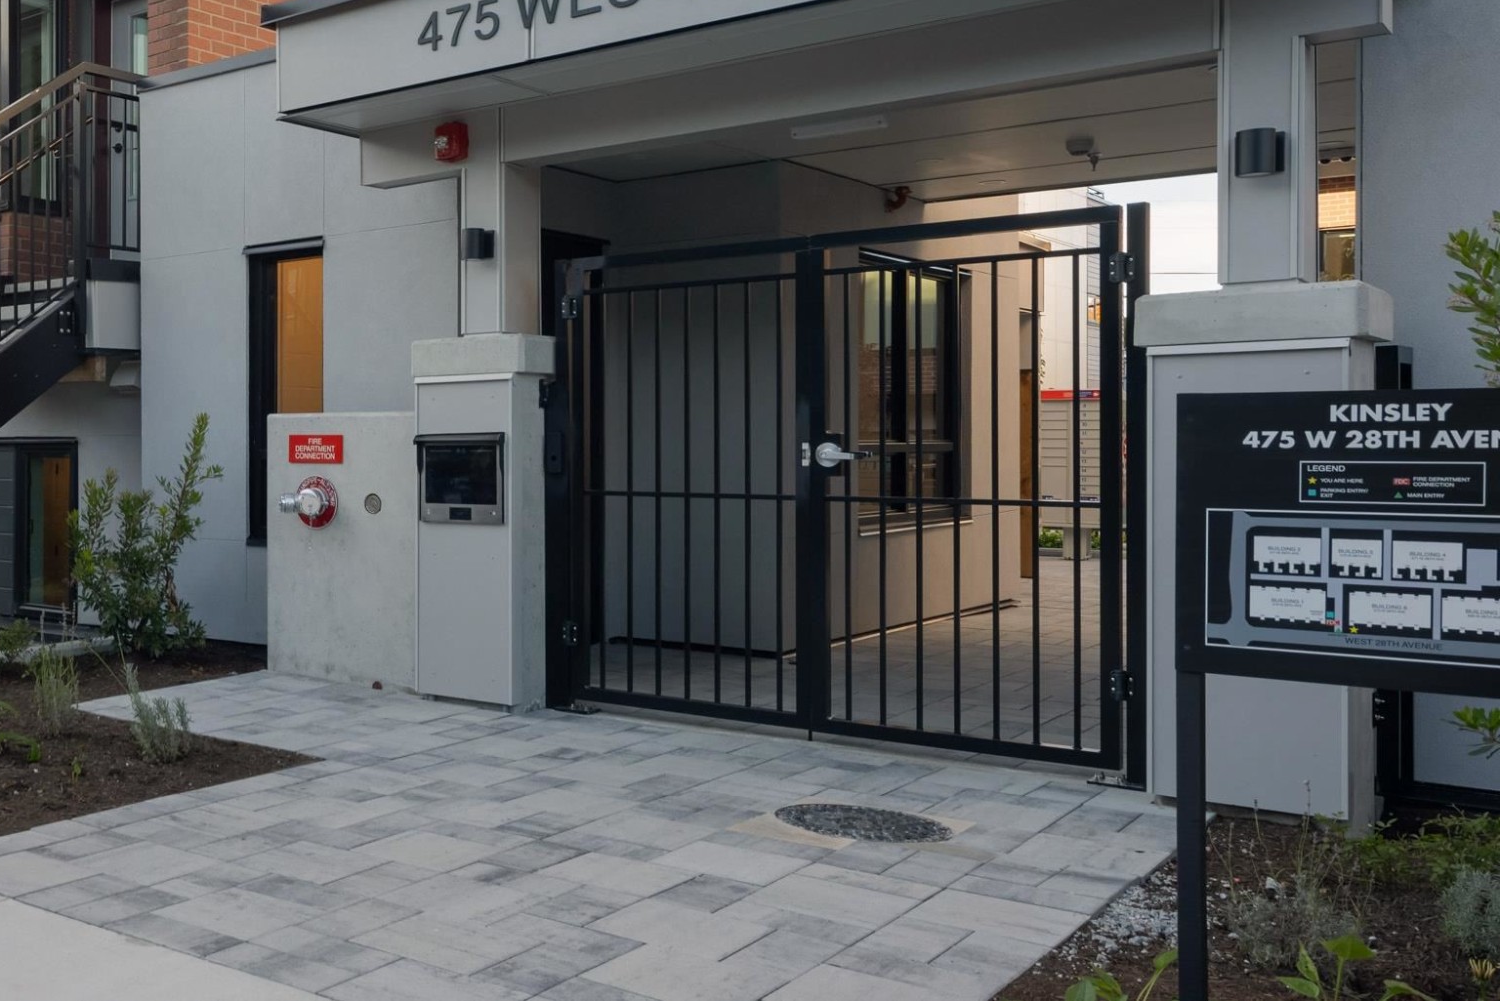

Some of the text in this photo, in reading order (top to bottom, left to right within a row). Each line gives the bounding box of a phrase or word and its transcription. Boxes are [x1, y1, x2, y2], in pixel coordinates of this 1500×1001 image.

[1330, 403, 1453, 422] KINSLEY
[307, 437, 322, 445] FIRE
[1242, 430, 1295, 449] 475
[1304, 430, 1337, 448] W
[1345, 430, 1420, 449] 28TH
[295, 445, 335, 453] DEPARTMENT
[295, 452, 336, 460] CONNECTION
[1344, 637, 1443, 651] WEST 28TH AVENUE
